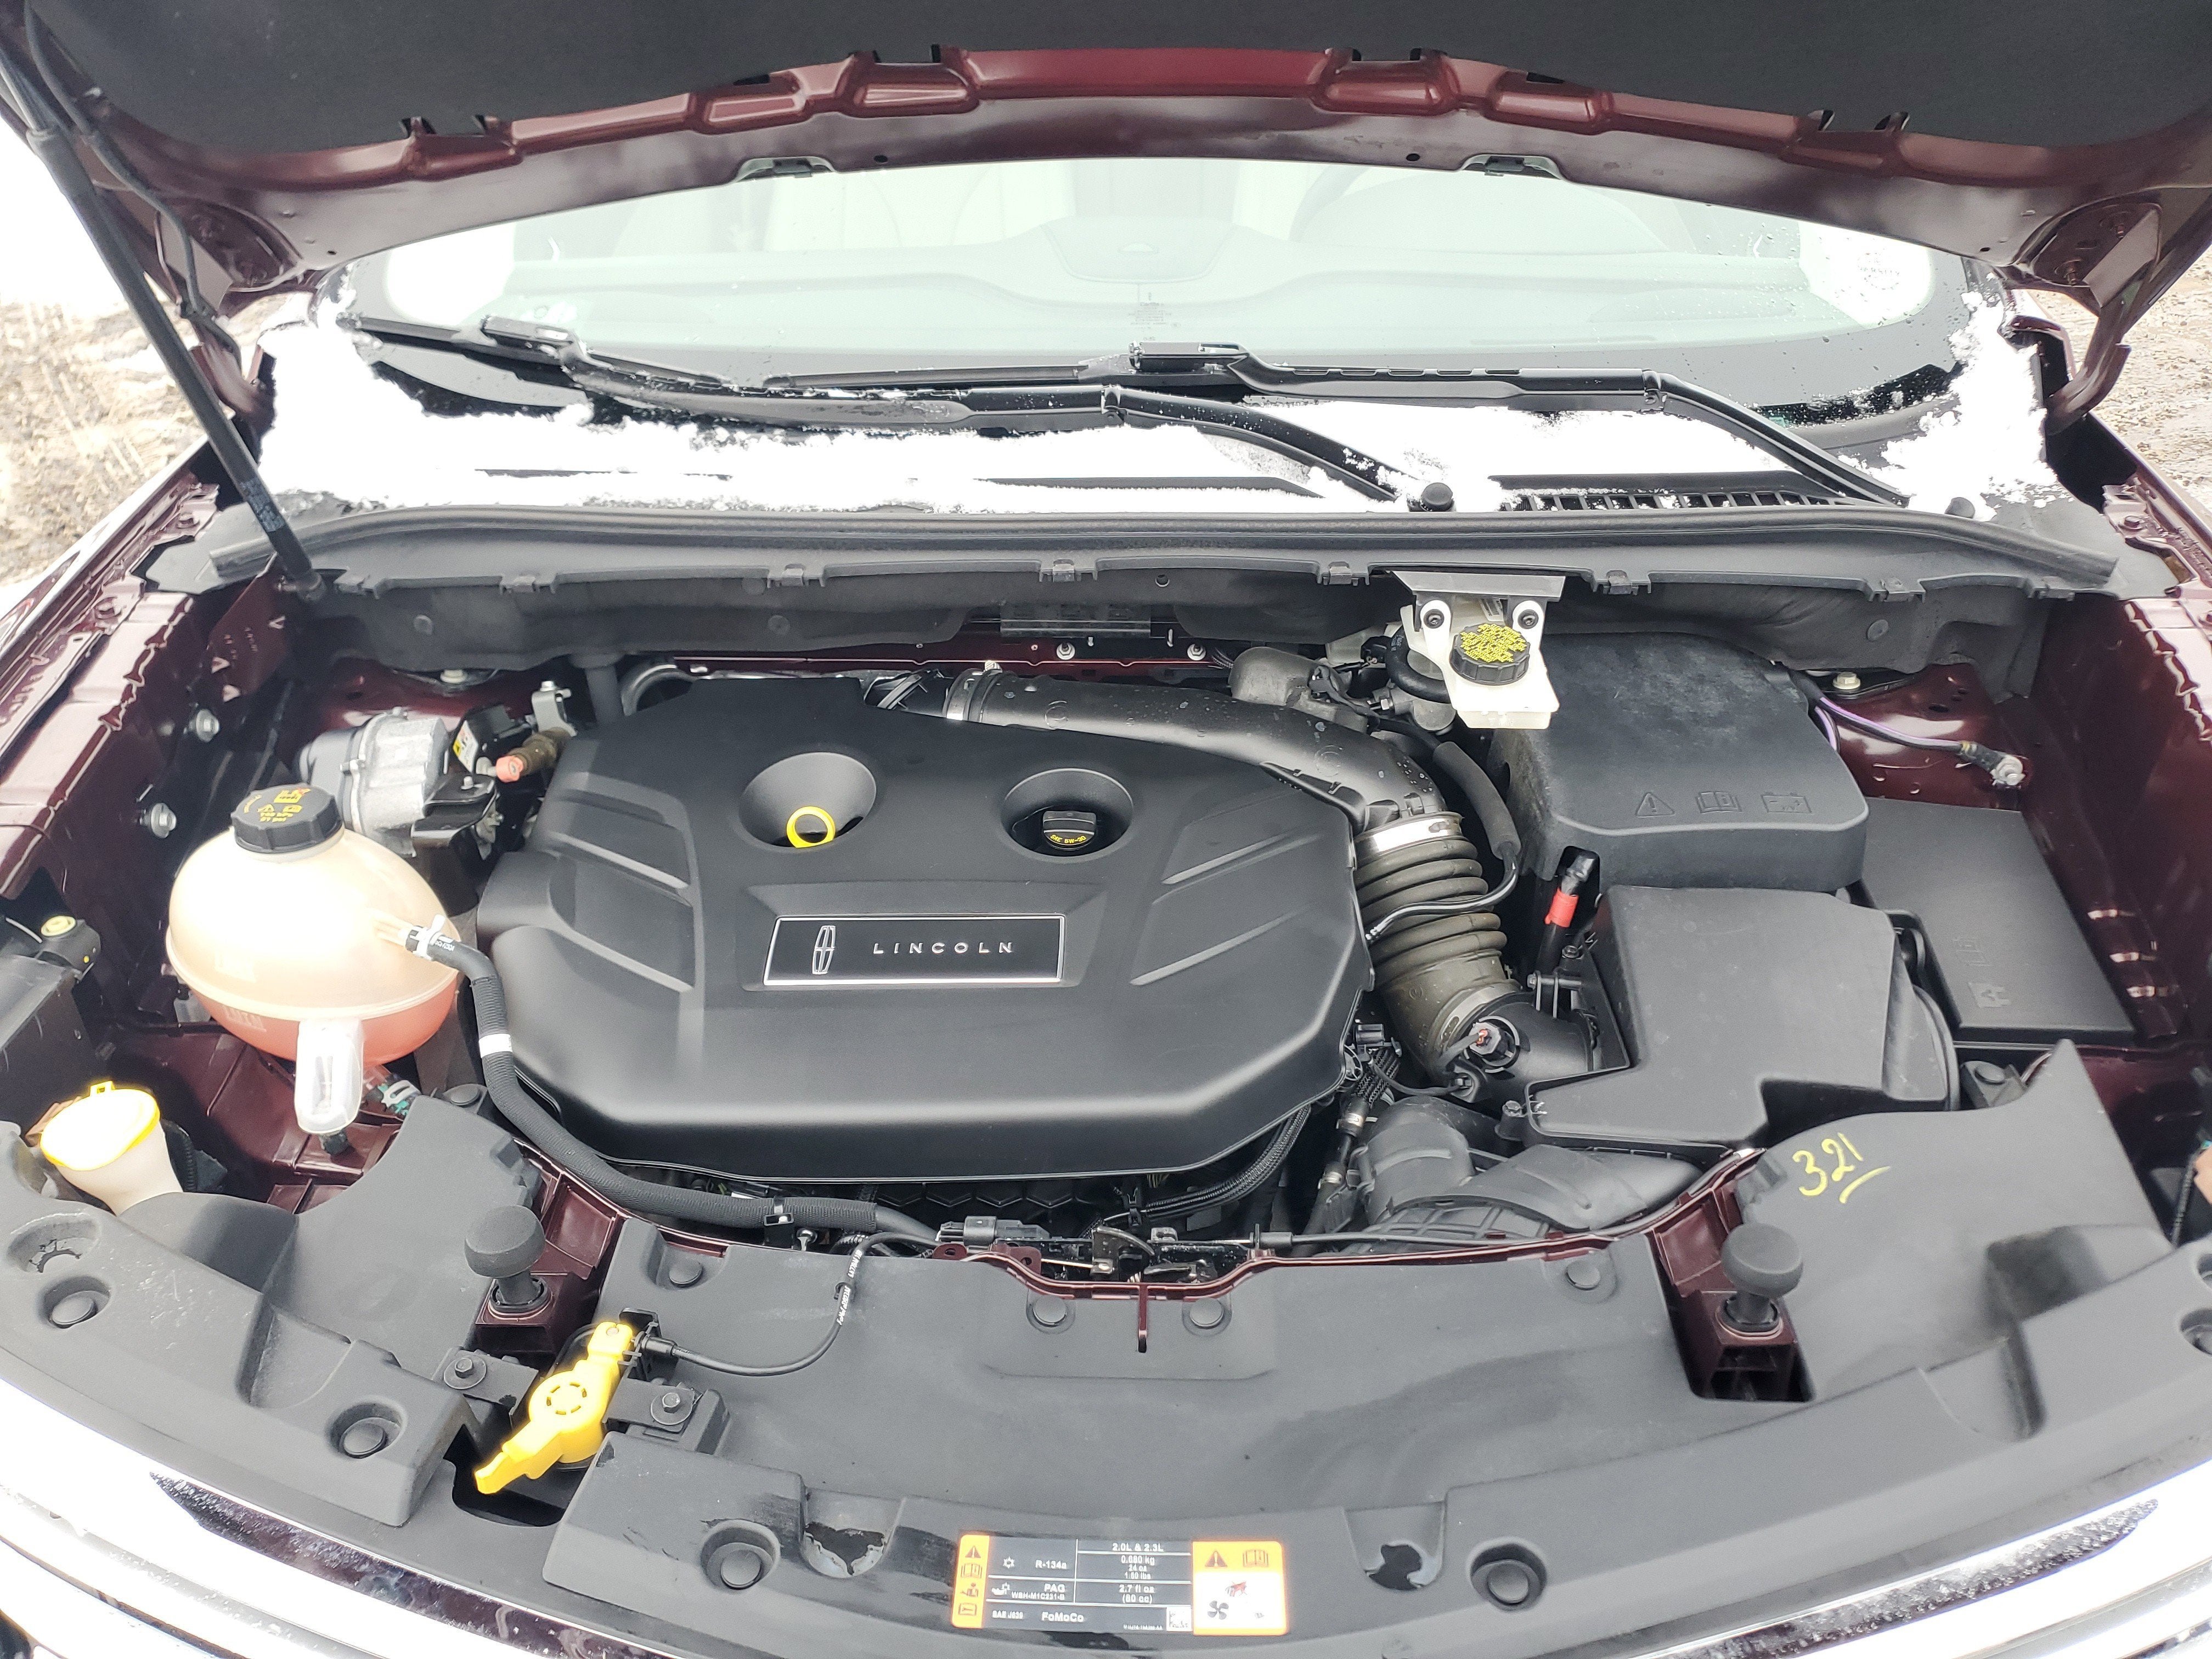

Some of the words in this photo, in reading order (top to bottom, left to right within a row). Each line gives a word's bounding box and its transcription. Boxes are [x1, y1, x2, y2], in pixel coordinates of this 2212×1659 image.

[873, 941, 1013, 954] LINCOLN
[1792, 1132, 1864, 1197] 321
[1112, 1543, 1132, 1551] 2.0L
[1135, 1543, 1142, 1551] &
[1144, 1543, 1165, 1552] 2.3L
[1035, 1560, 1067, 1570] R-134a
[1144, 1555, 1155, 1566] kg
[1044, 1583, 1065, 1593] PAG
[1119, 1584, 1133, 1593] 2.7
[1135, 1584, 1141, 1593] fl
[992, 1610, 1006, 1619] SAE
[1041, 1611, 1085, 1622] FoMoCo
